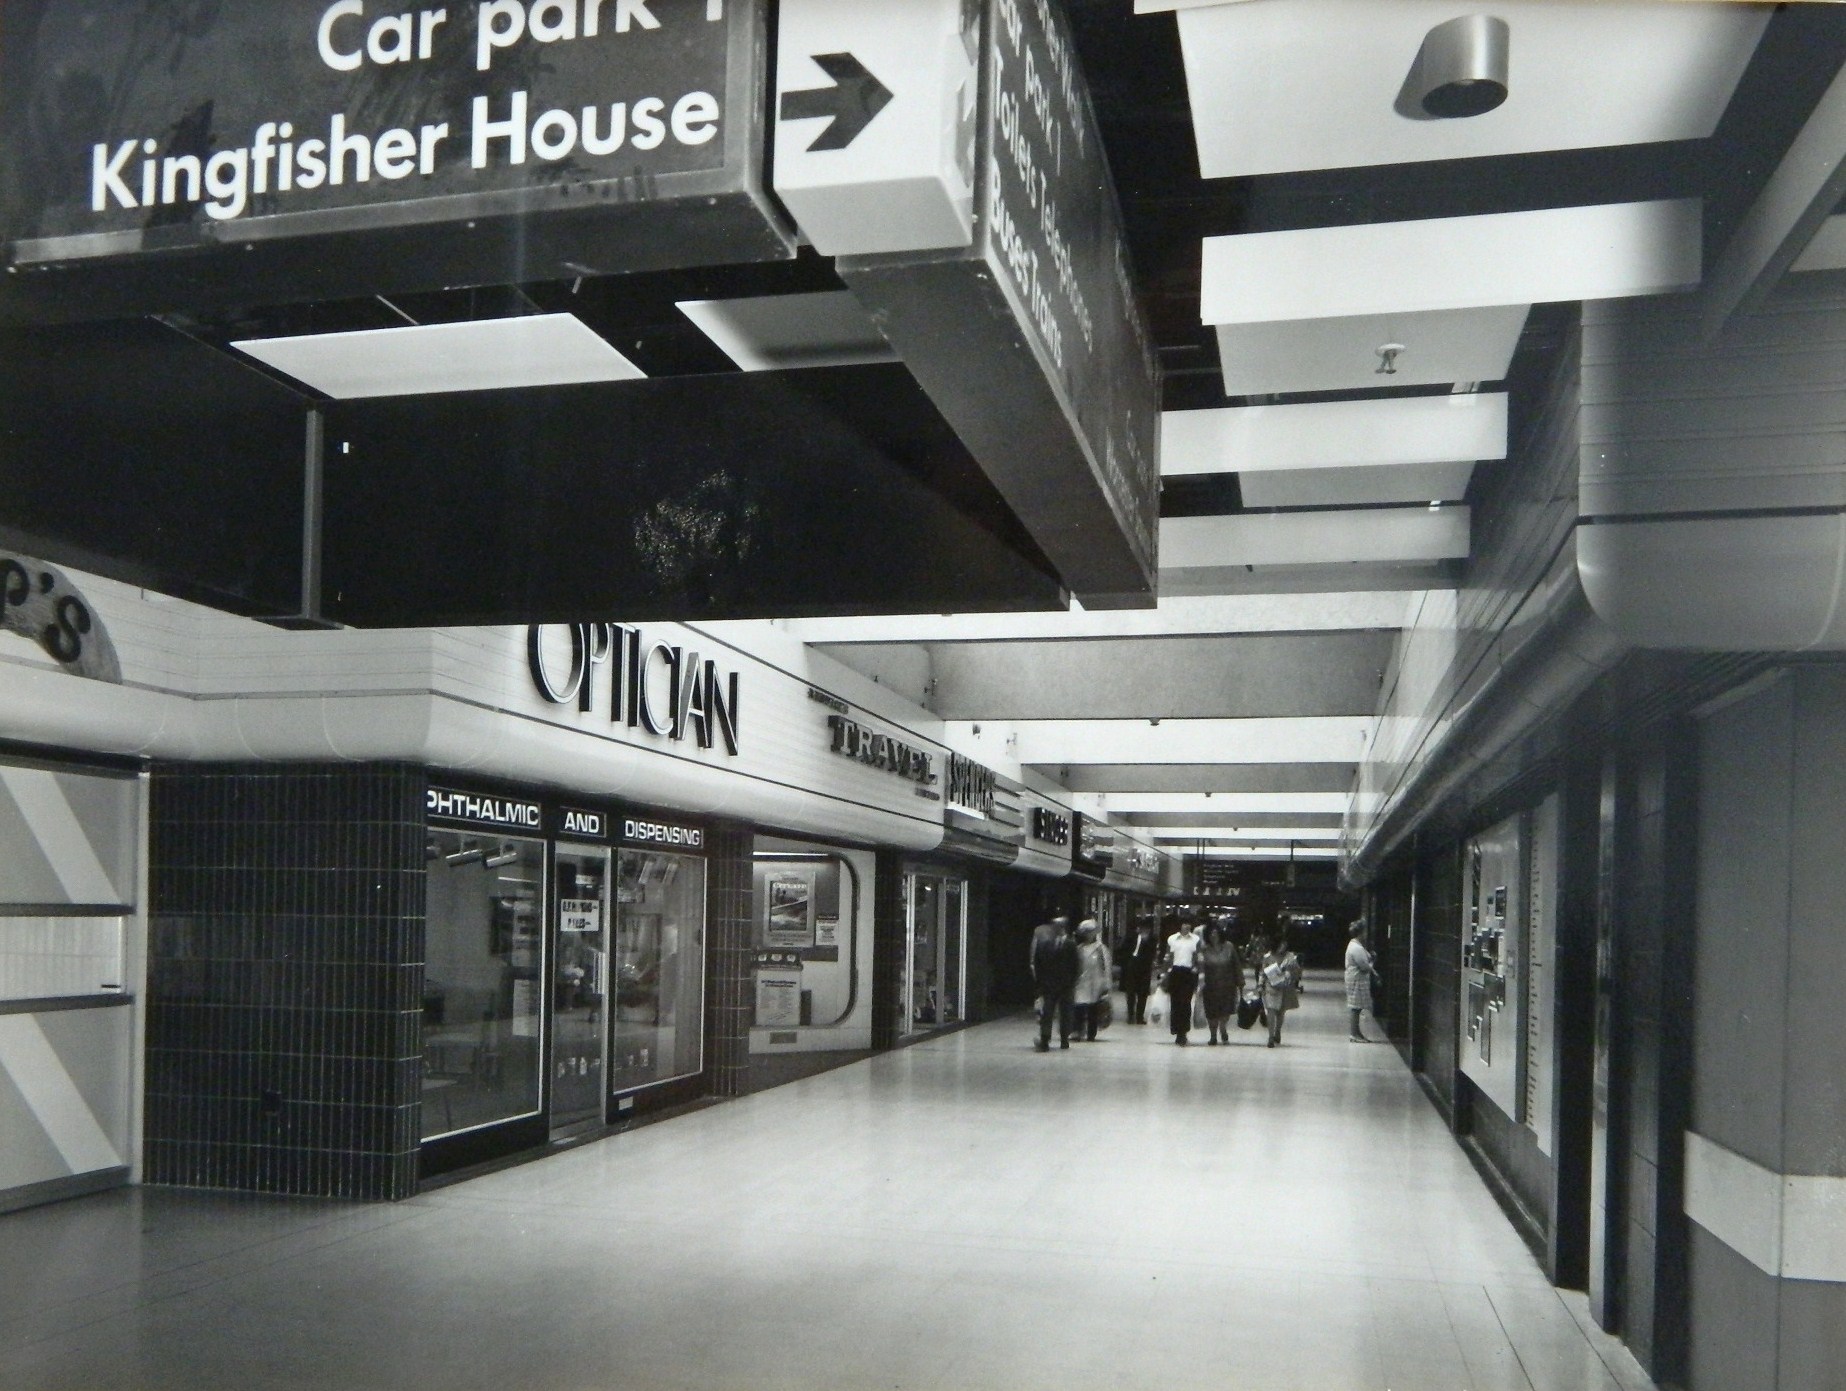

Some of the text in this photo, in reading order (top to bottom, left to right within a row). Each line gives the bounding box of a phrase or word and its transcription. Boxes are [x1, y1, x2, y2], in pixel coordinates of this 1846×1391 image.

[317, 0, 447, 71] Car
[92, 90, 719, 220] Kingfisher House
[1025, 44, 1052, 153] park
[992, 44, 1092, 352] Toilets Telephones
[990, 155, 1062, 368] Buses Trains
[527, 622, 738, 756] OPTICIAN
[827, 715, 938, 785] TRAVEL
[565, 812, 599, 834] AND
[625, 819, 699, 846] DISPENSING
